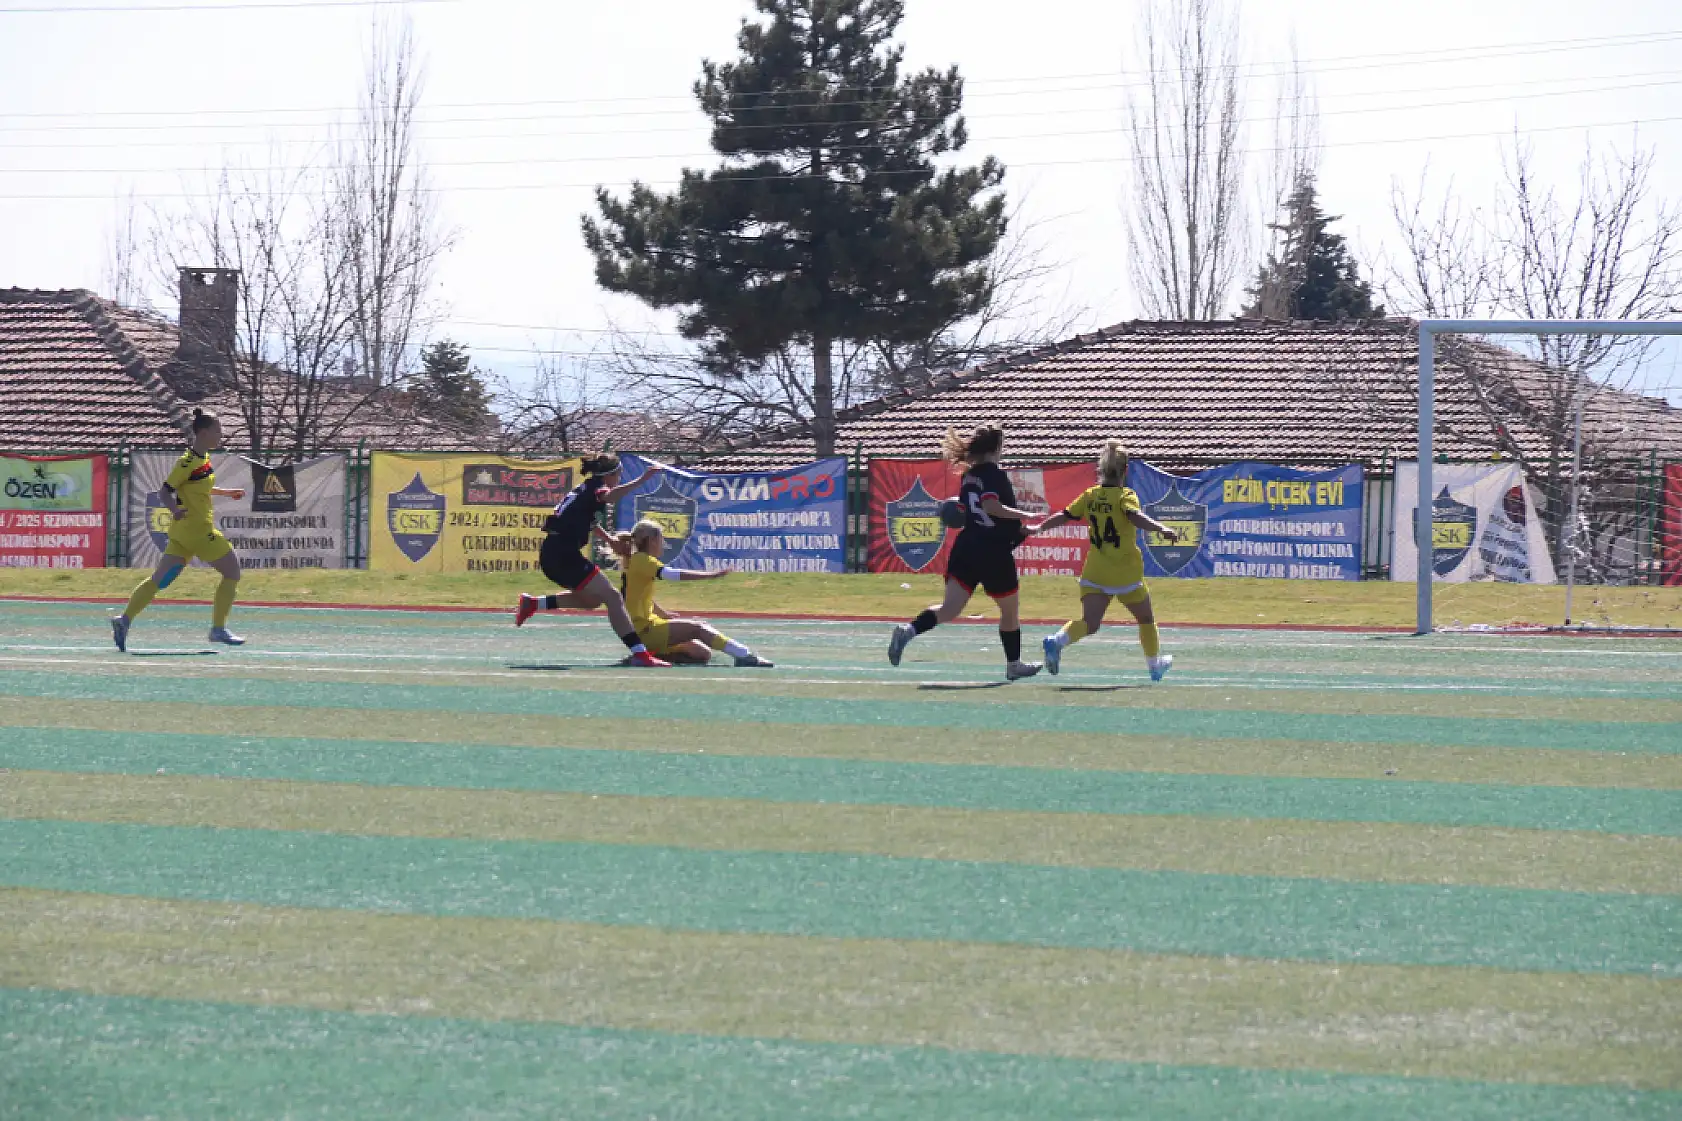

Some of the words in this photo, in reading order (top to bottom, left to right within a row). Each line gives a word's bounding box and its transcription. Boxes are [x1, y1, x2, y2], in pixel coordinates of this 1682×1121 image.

[4, 477, 57, 499] ÖZEN
[1266, 476, 1312, 511] ÇİÇEK
[1315, 476, 1344, 506] EVİ
[450, 511, 480, 527] 2024
[491, 512, 519, 528] 2025
[967, 491, 997, 527] 5
[1088, 514, 1121, 549] 14
